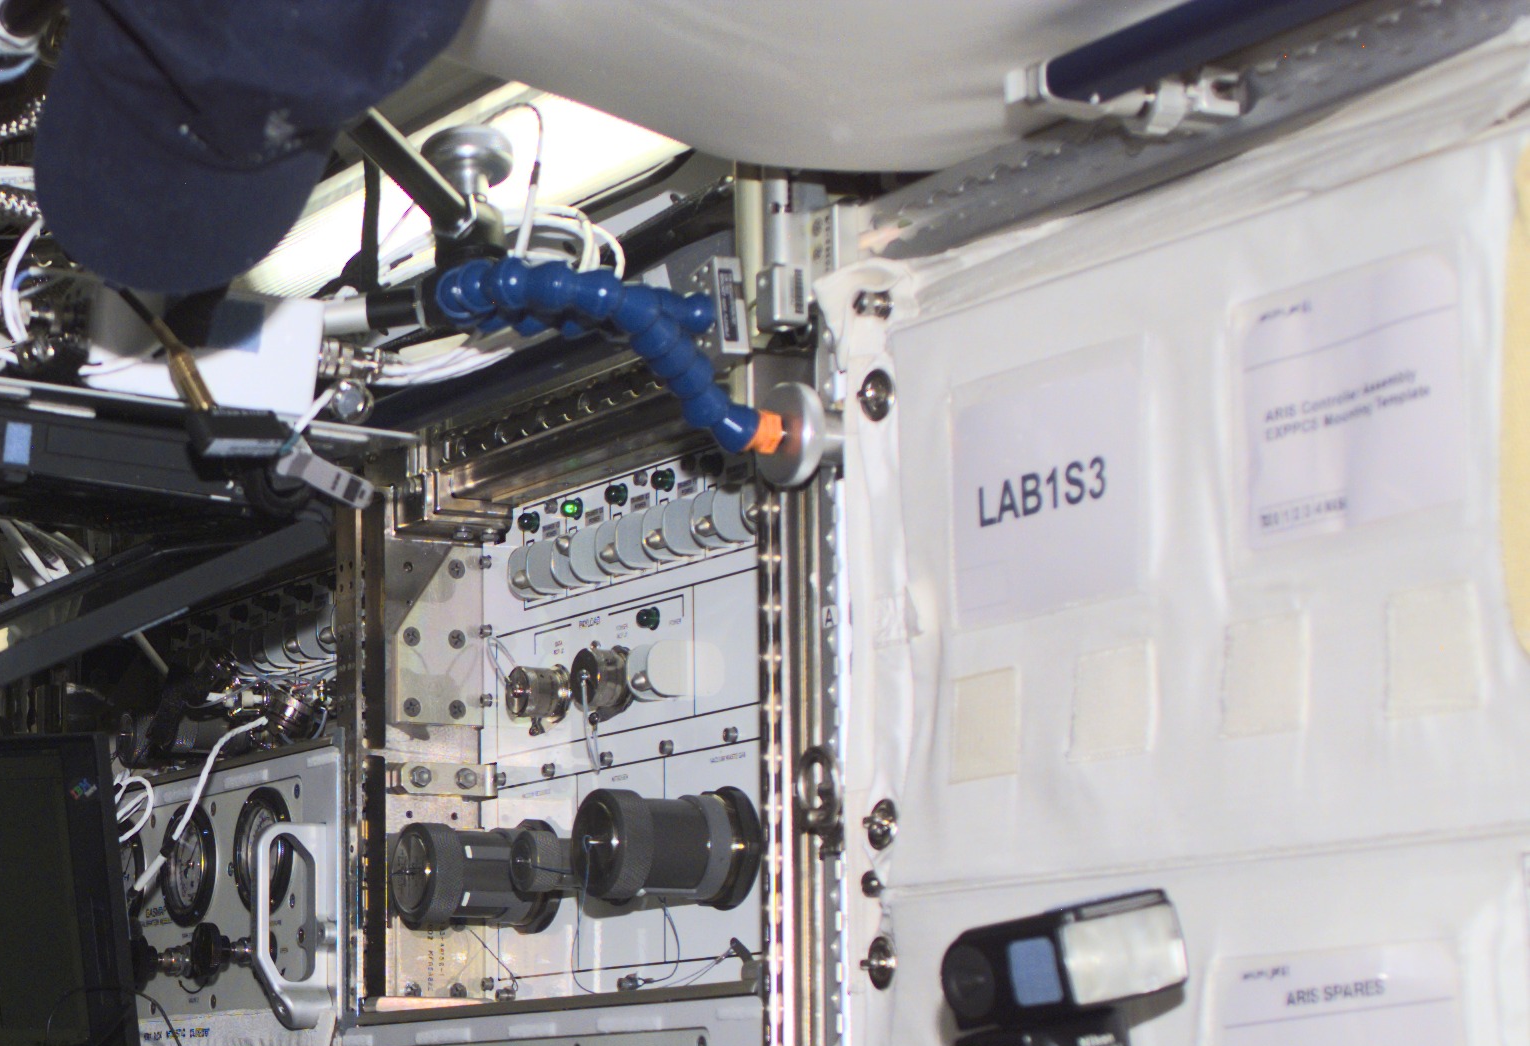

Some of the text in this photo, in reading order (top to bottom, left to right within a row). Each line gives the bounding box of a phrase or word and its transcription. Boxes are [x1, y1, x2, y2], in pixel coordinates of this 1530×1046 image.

[978, 455, 1106, 527] LAB1S3
[824, 607, 834, 627] A
[1286, 978, 1385, 1007] ARIS SPARES
